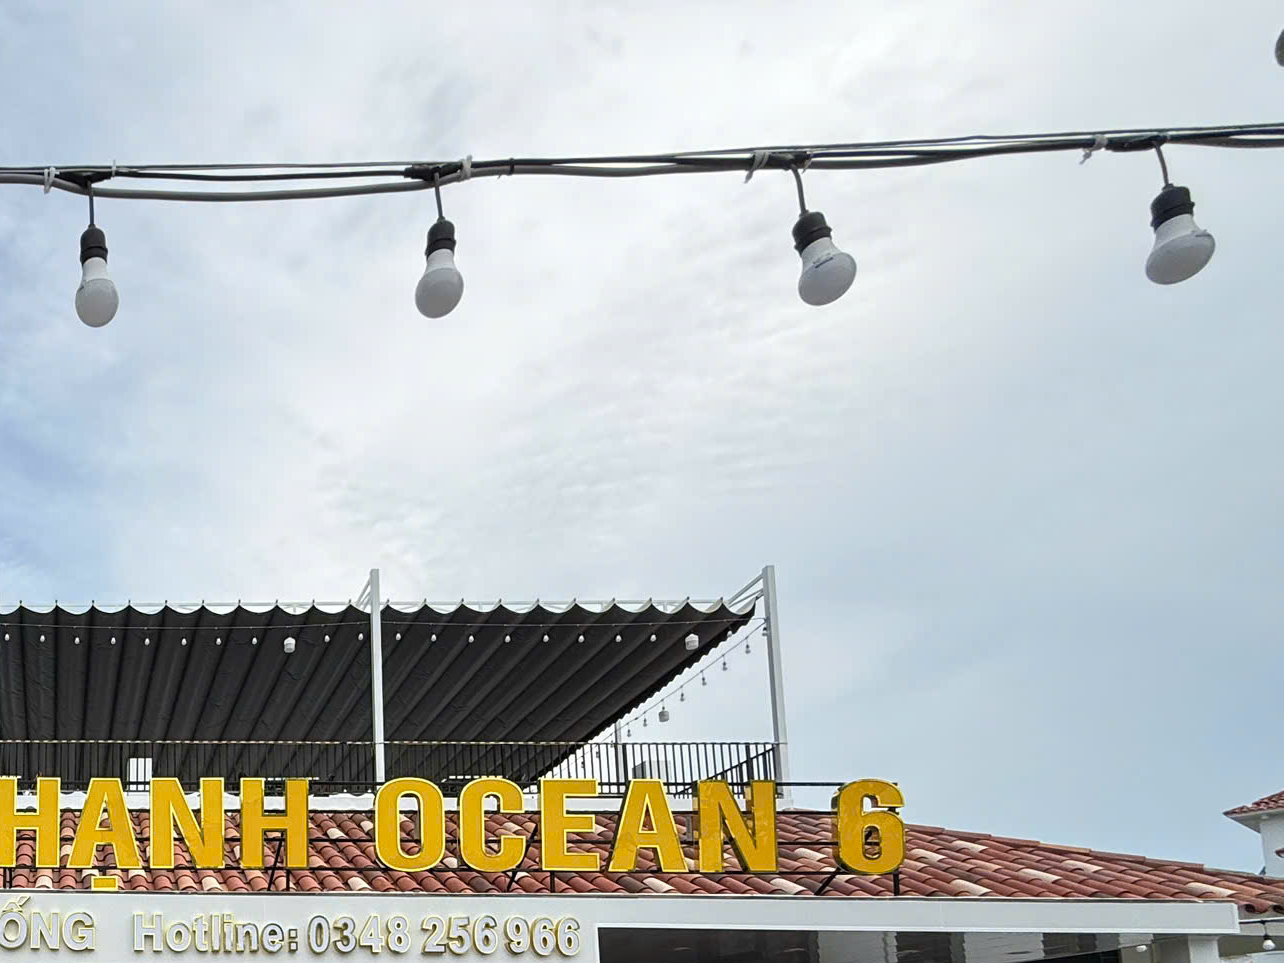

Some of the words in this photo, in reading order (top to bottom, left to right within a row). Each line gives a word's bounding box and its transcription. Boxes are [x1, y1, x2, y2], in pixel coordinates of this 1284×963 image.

[374, 777, 779, 874] OCEAN
[831, 778, 906, 875] 6
[132, 912, 299, 954] Hotline:
[307, 913, 412, 954] 0348
[421, 914, 498, 956] 256
[505, 915, 582, 957] 966
